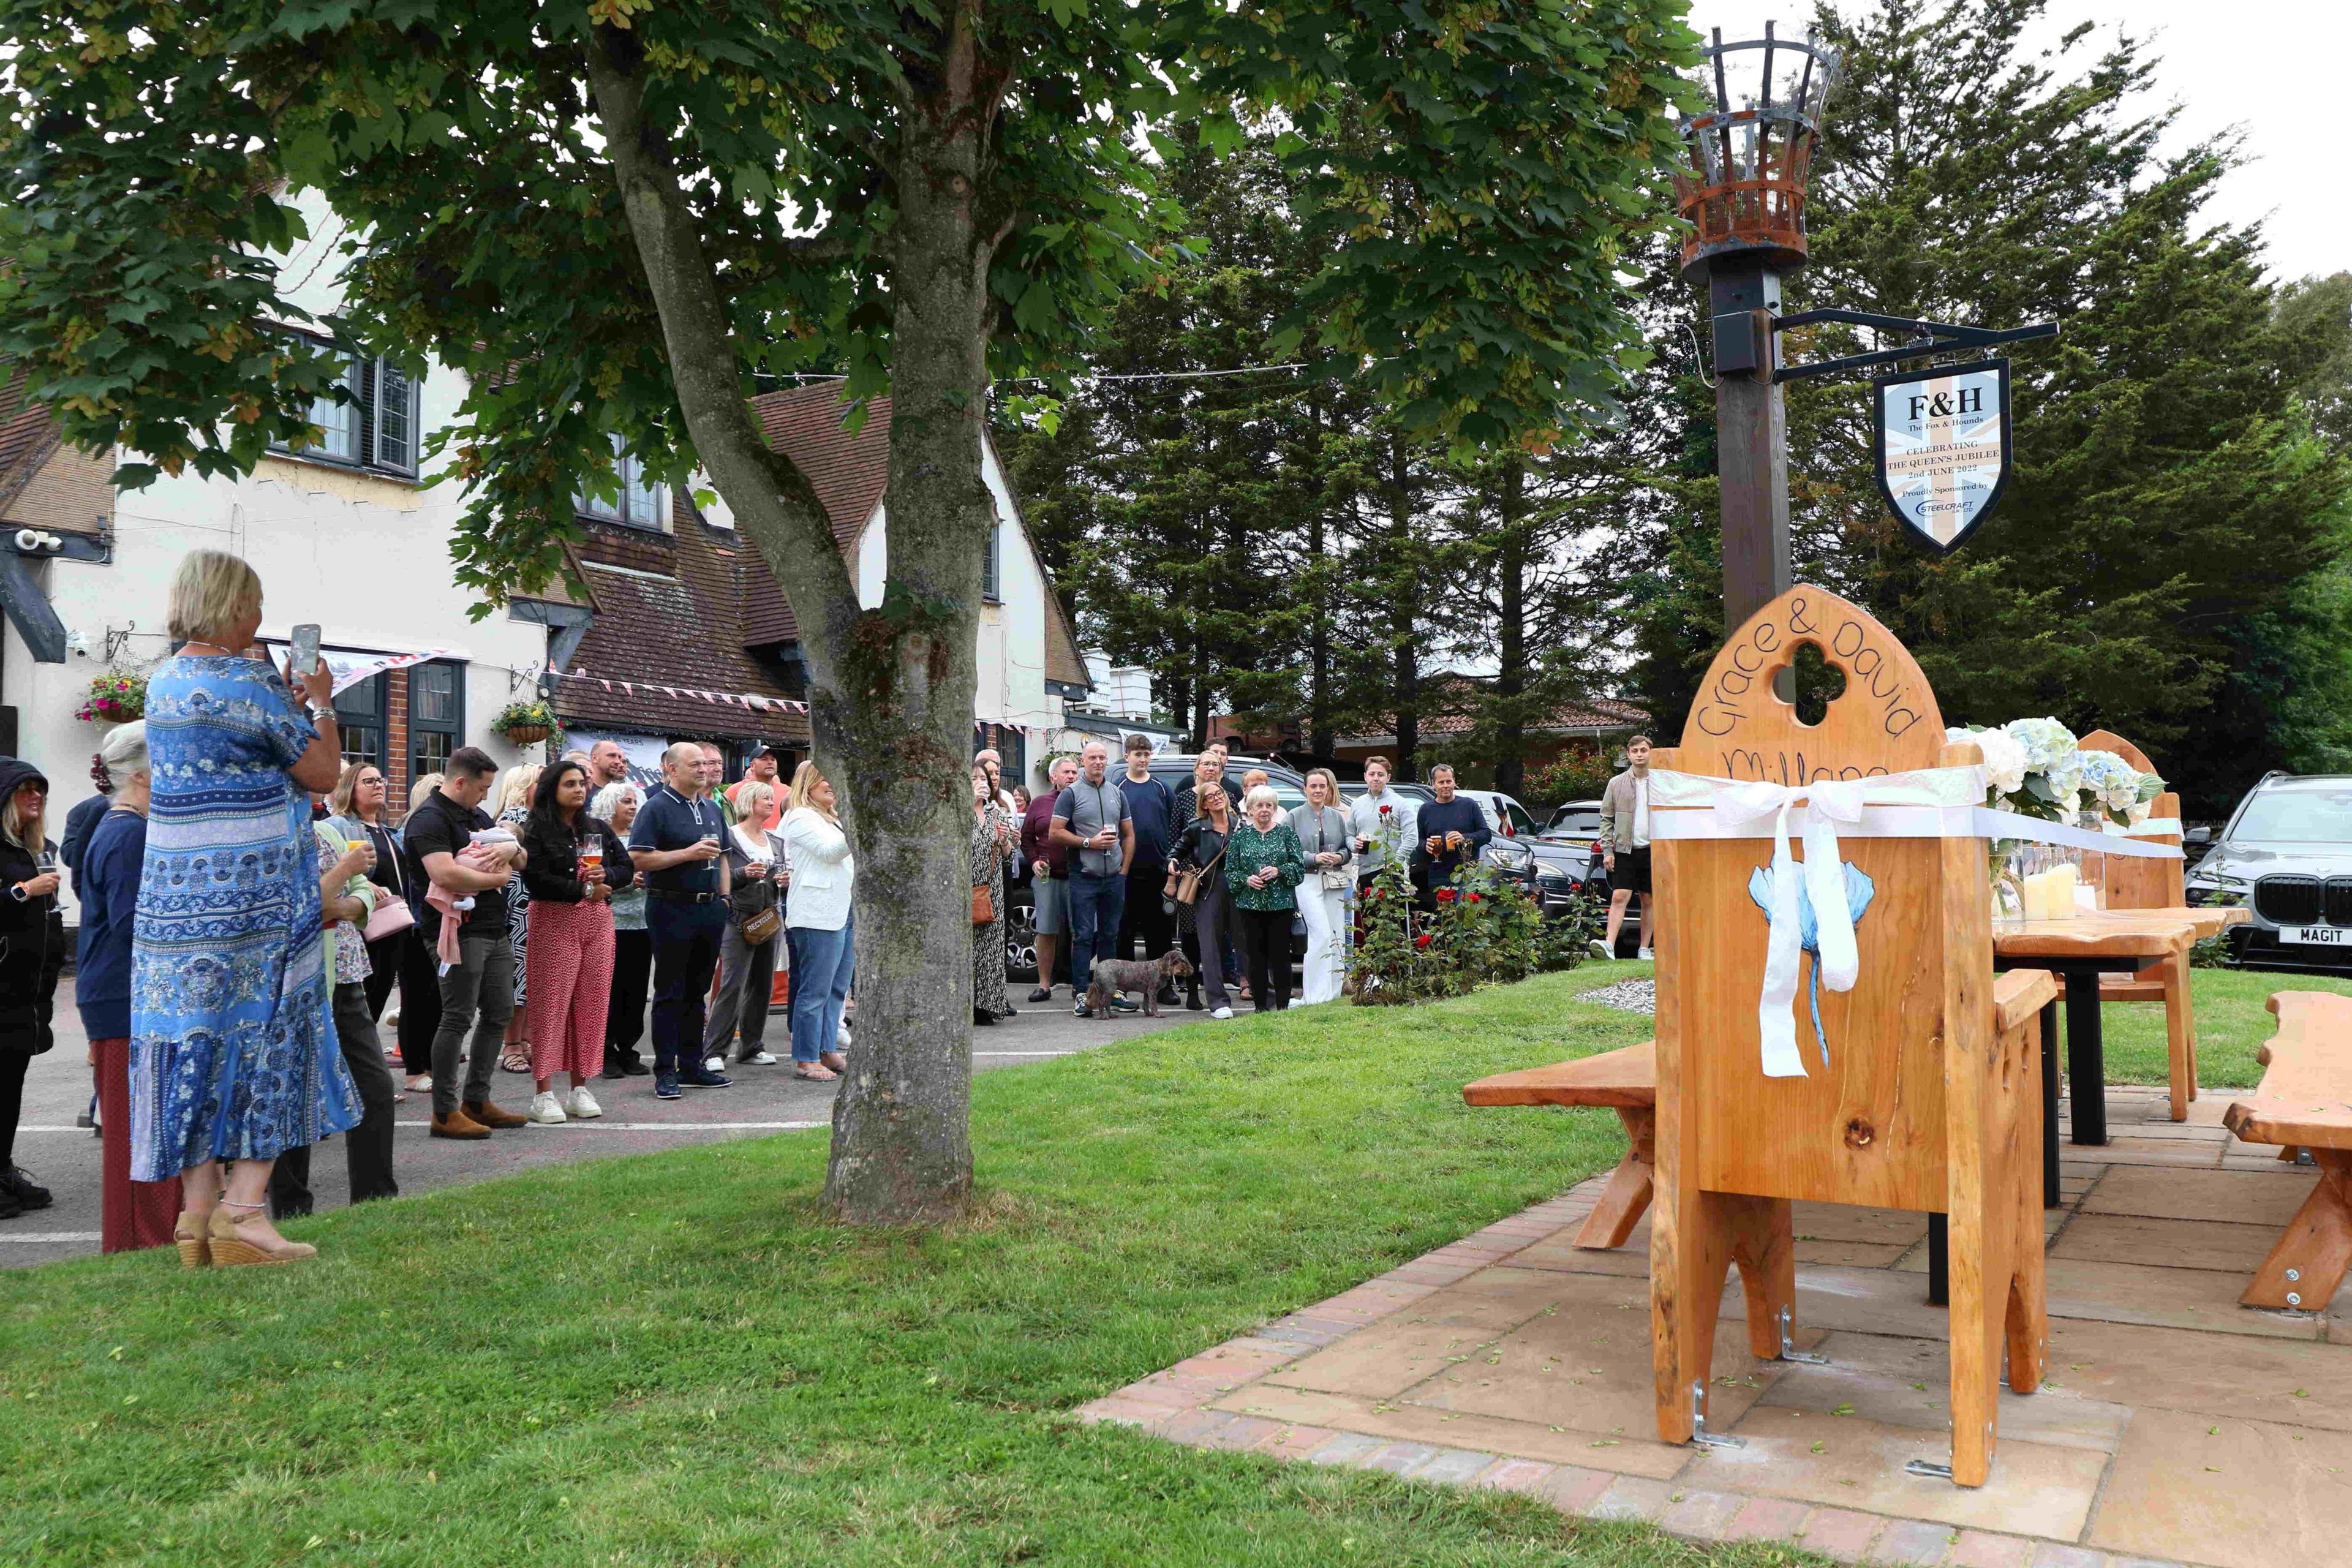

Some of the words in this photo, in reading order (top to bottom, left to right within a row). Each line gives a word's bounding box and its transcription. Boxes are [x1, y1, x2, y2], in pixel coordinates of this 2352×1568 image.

[1908, 387, 1983, 421] F&H
[1908, 424, 1923, 432] The
[1952, 416, 1984, 426] Hounds
[1906, 440, 1978, 456] CELEBRATING
[1887, 461, 1907, 470] THE
[1909, 455, 1953, 469] QUEEN'S
[1954, 450, 2000, 462] JUBILEE
[1908, 471, 1924, 480] 2nd
[1927, 467, 1954, 477] JUNE
[1956, 464, 1977, 473] 2022
[1902, 488, 1933, 498] Proudly
[1934, 482, 1977, 494] Sponsored
[1978, 482, 1989, 491] by
[1920, 500, 1974, 513] STEELCRAFT
[1698, 622, 1782, 737] Grace
[1789, 597, 1820, 635] &
[1831, 620, 1923, 741] David
[622, 737, 644, 746] YEARS
[747, 911, 774, 932] RECYCLED
